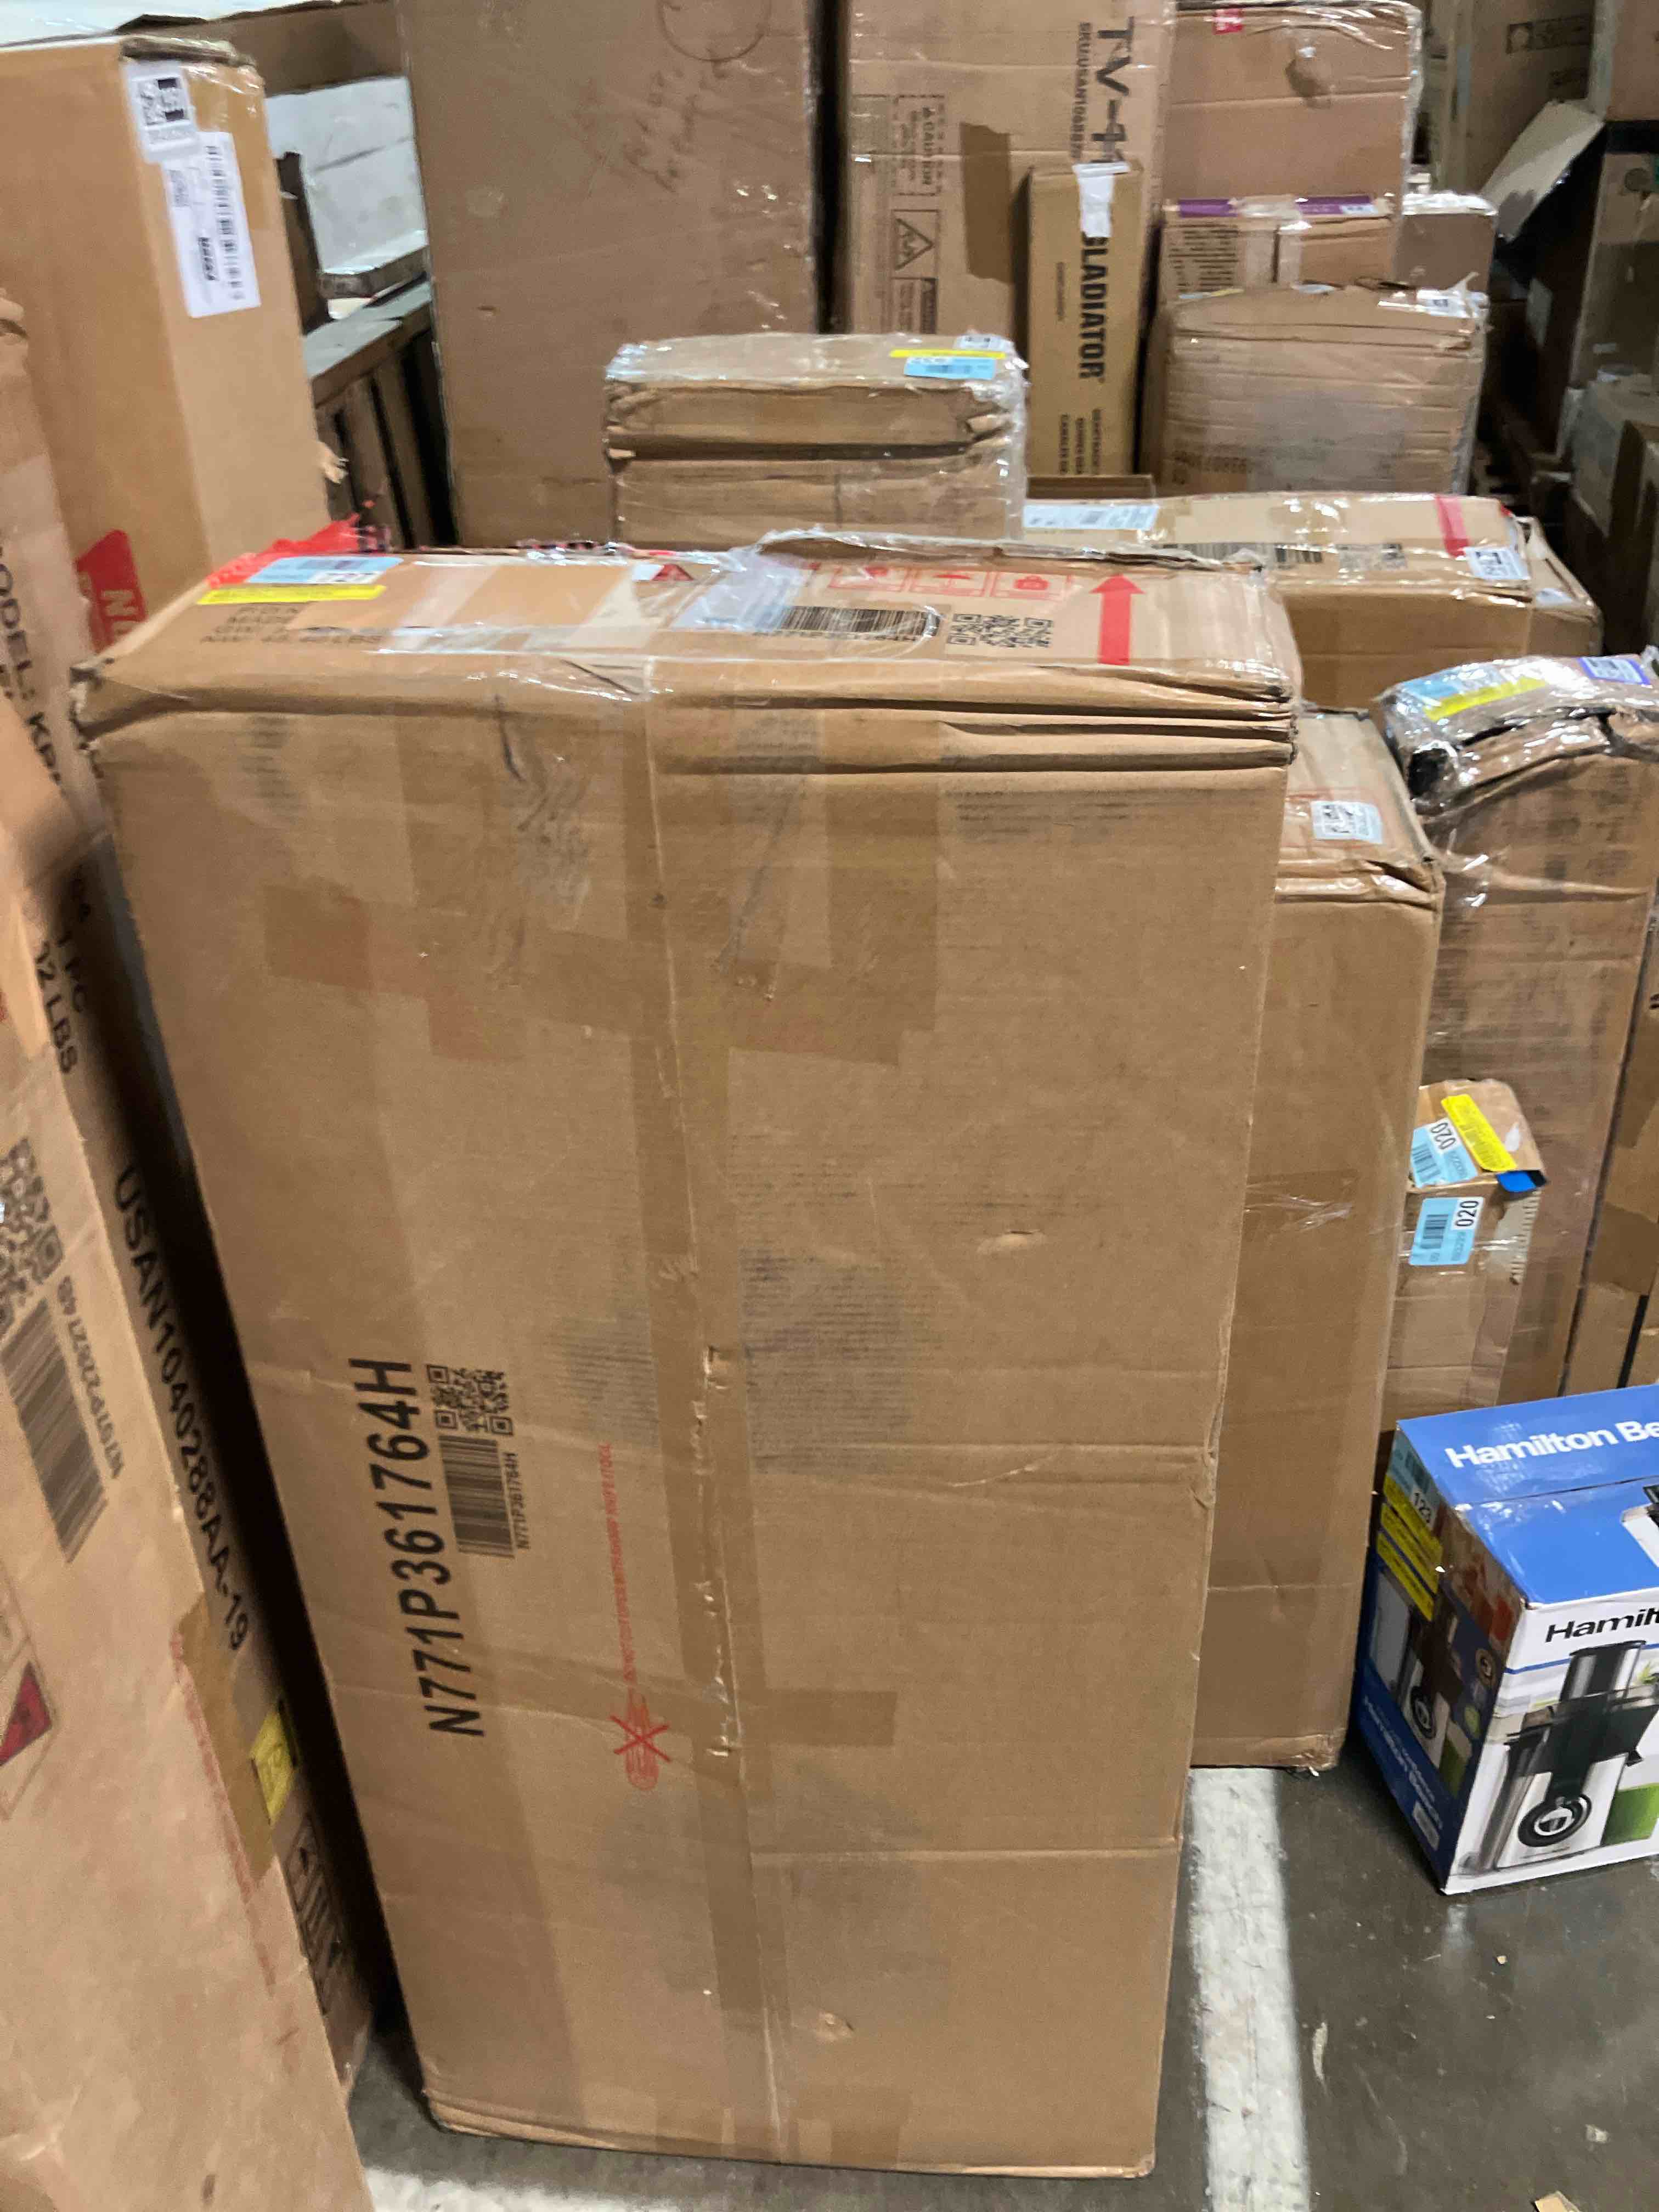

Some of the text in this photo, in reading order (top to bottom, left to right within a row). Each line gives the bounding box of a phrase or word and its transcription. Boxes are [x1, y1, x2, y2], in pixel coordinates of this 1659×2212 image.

[0, 546, 36, 701] ODEL:
[1431, 1122, 1457, 1150] 020
[1455, 1200, 1480, 1228] 020
[1446, 1429, 1619, 1469] Hamilton
[348, 1357, 485, 1737] N771P361764H
